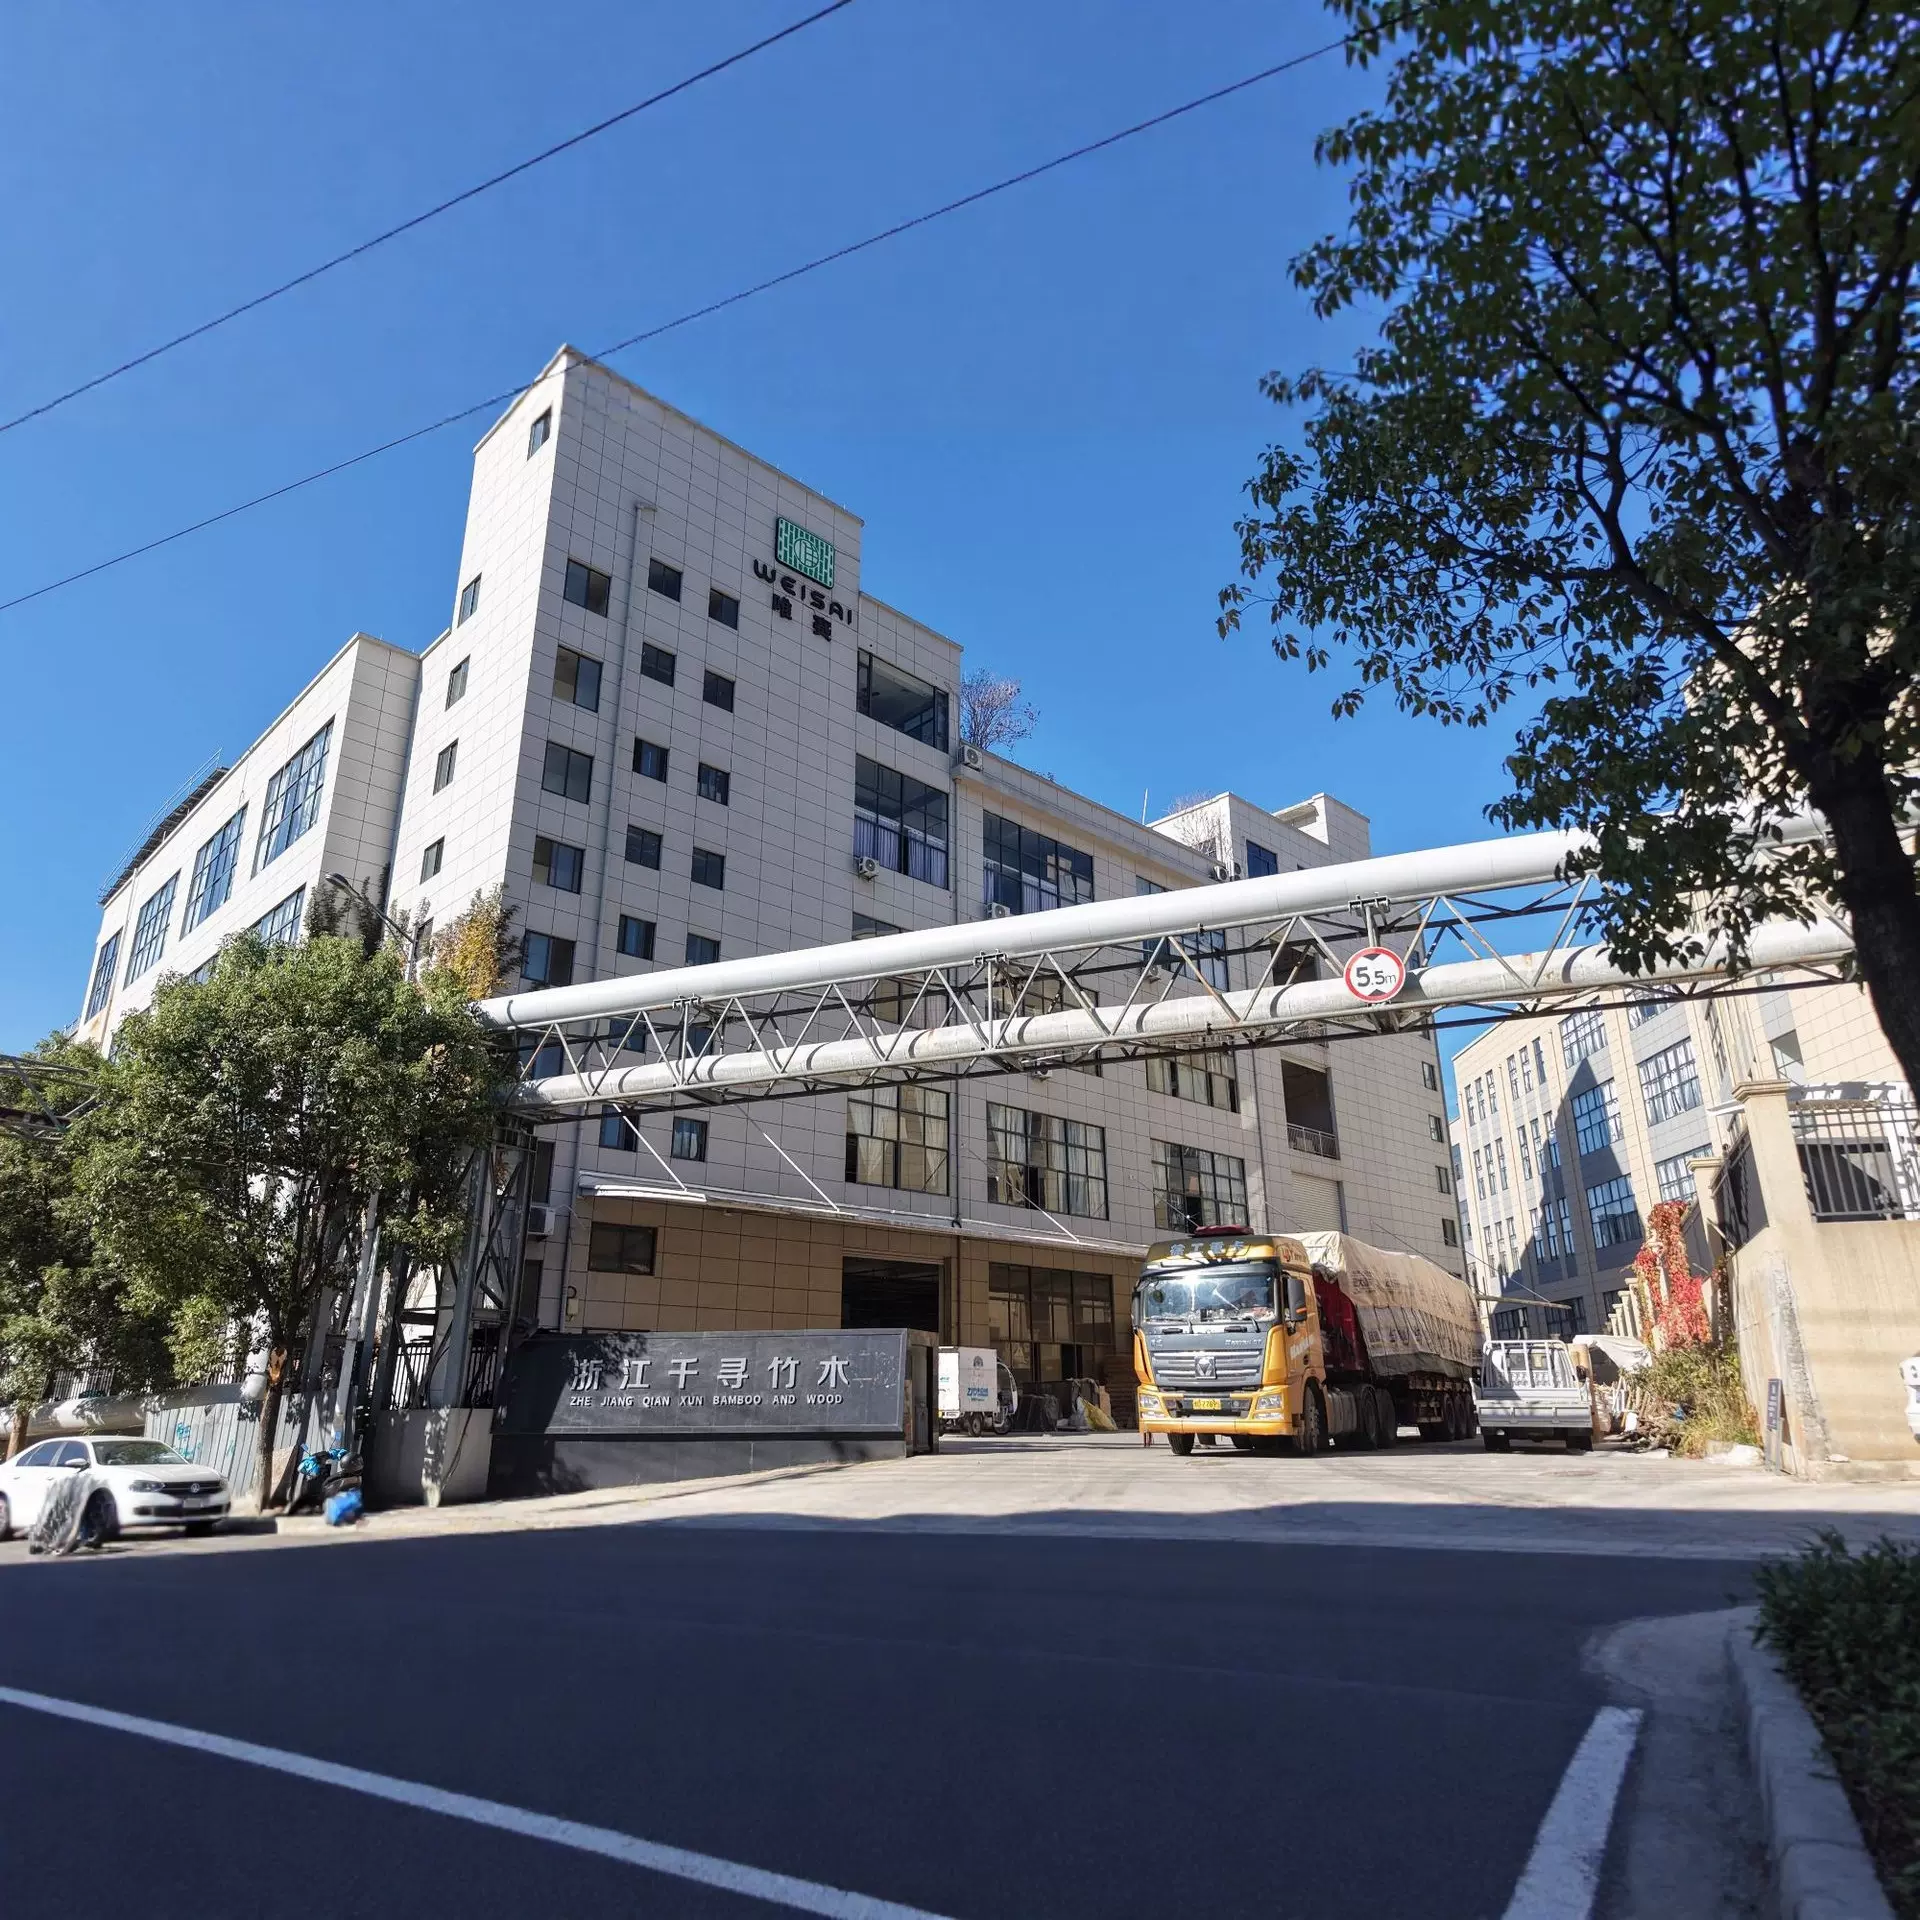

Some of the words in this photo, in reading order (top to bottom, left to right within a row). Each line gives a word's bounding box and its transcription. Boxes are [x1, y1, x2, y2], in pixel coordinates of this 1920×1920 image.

[753, 558, 852, 625] WEISAI
[1356, 966, 1396, 987] 5.5m
[570, 1356, 849, 1391] 浙江千寻竹木
[569, 1396, 592, 1407] ZHE
[600, 1396, 634, 1407] JIANG
[642, 1396, 671, 1408] QIAN
[679, 1396, 704, 1407] XUN
[712, 1395, 762, 1406] BAMBOO
[773, 1395, 797, 1405] AND
[806, 1394, 843, 1405] WOOD
